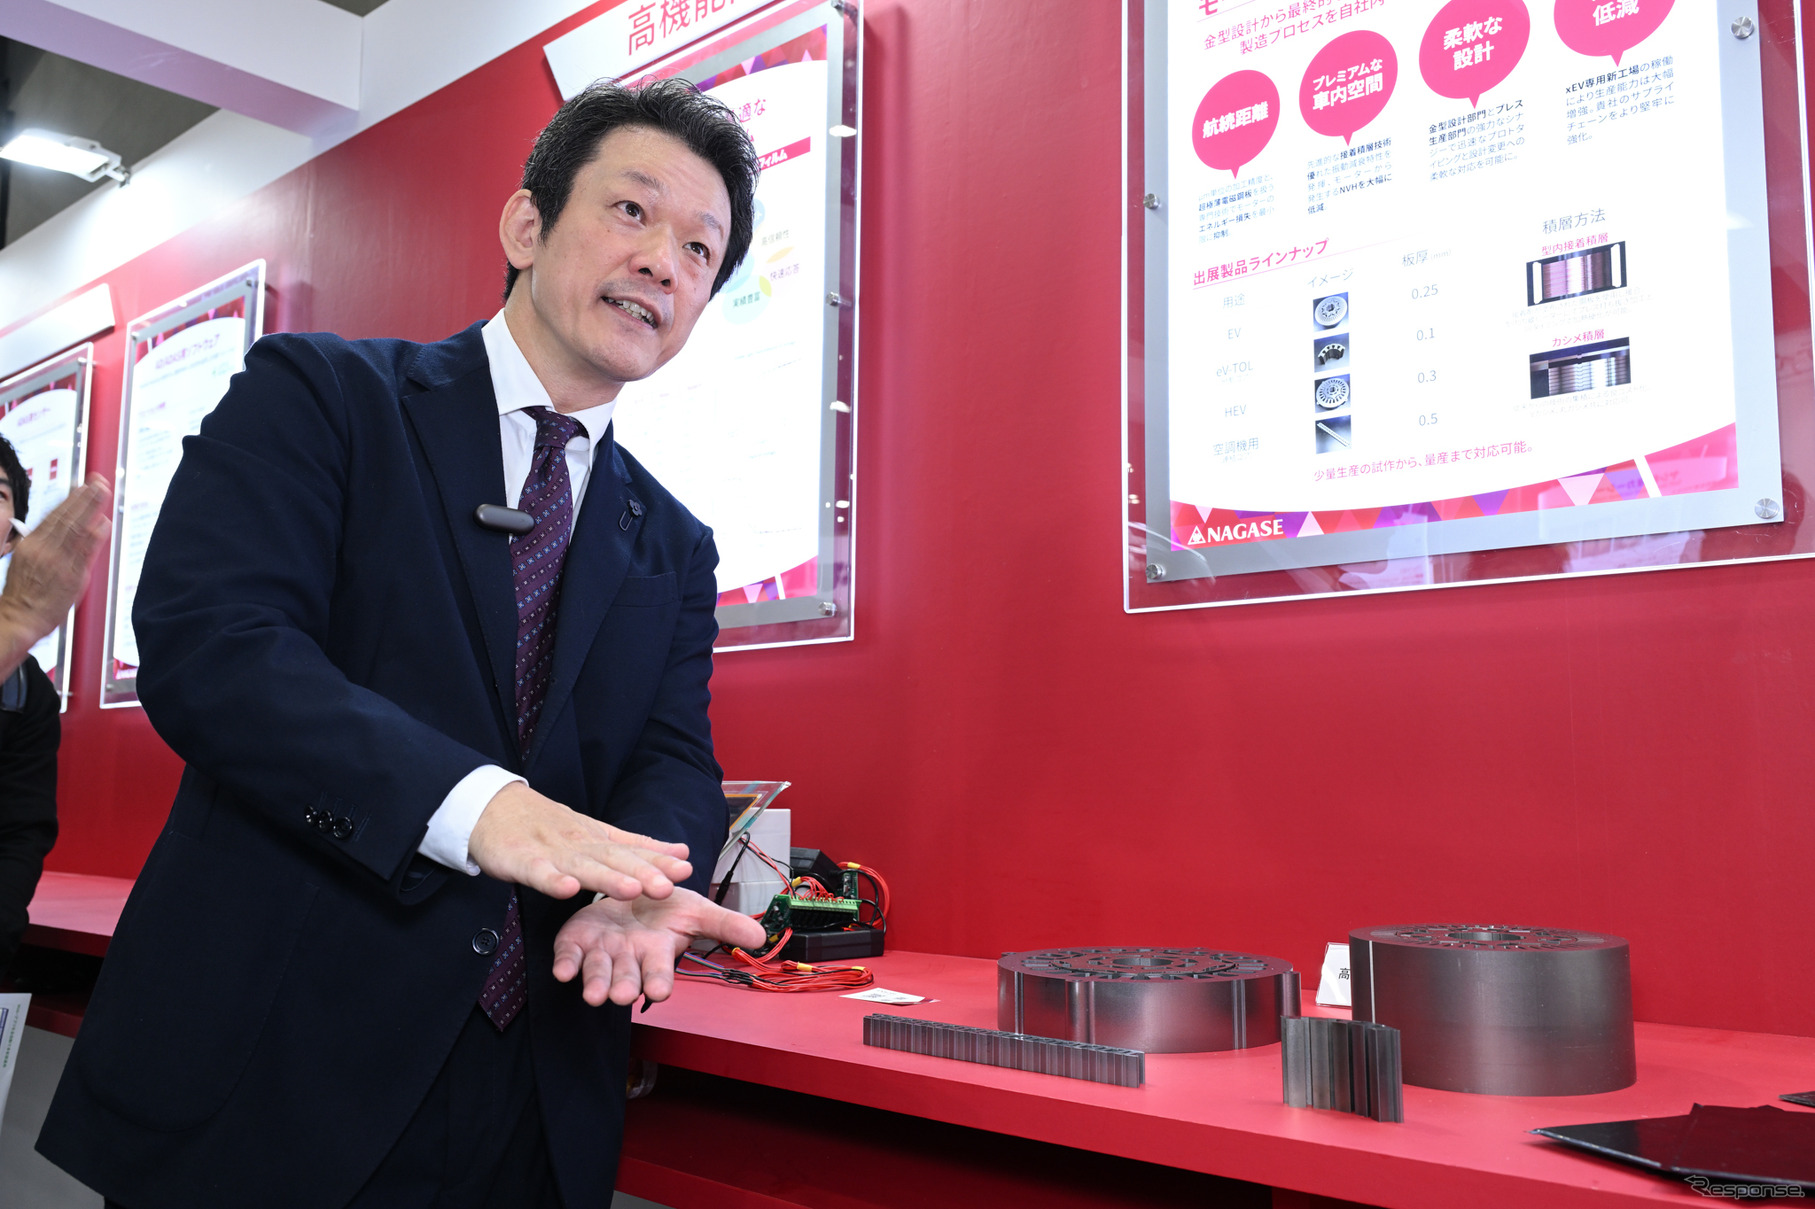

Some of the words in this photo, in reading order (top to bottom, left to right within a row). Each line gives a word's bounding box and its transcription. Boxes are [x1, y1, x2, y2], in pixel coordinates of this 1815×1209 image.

[1204, 0, 1340, 50] 金型設計から最終的
[1592, 0, 1640, 26] 低減
[1443, 16, 1503, 50] 柔軟な
[1453, 41, 1494, 70] 設計
[1313, 58, 1383, 91] プレミアムな
[1565, 55, 1673, 94] xEV専用新工場の稼働
[1566, 68, 1674, 106] により生産能力は大幅
[1312, 72, 1383, 110] 車内空間
[1567, 81, 1674, 119] 増強。貴社のサプライ
[1203, 101, 1268, 138] 航続距離
[1429, 100, 1523, 134] 金型設計部門とプレス
[1567, 95, 1675, 132] チェーンをより堅牢に
[1429, 112, 1524, 146] 生産部門の強力なシナ
[1567, 132, 1593, 145] 強化。
[1430, 136, 1525, 169] イピングと設計変更への
[1542, 208, 1606, 234] 積層方法
[1542, 232, 1609, 256] 型内接着積層
[1193, 237, 1329, 284] 出展製品ラインナップ
[1307, 268, 1353, 287] イメージ
[1223, 293, 1245, 309] 用途
[1411, 284, 1438, 300] 0.25
[1228, 327, 1241, 340] EV
[1416, 327, 1435, 341] 0.1
[1552, 329, 1605, 347] カシメ積層
[1216, 361, 1253, 377] eV-TOL
[1417, 370, 1437, 384] 0.3
[1225, 404, 1247, 417] HEV
[1419, 413, 1438, 427] 0.5
[1213, 437, 1259, 456] 空調機用
[1314, 440, 1533, 482] 少量生産の試作から、量産まで対応可能。
[1207, 519, 1284, 542] NAGASE
